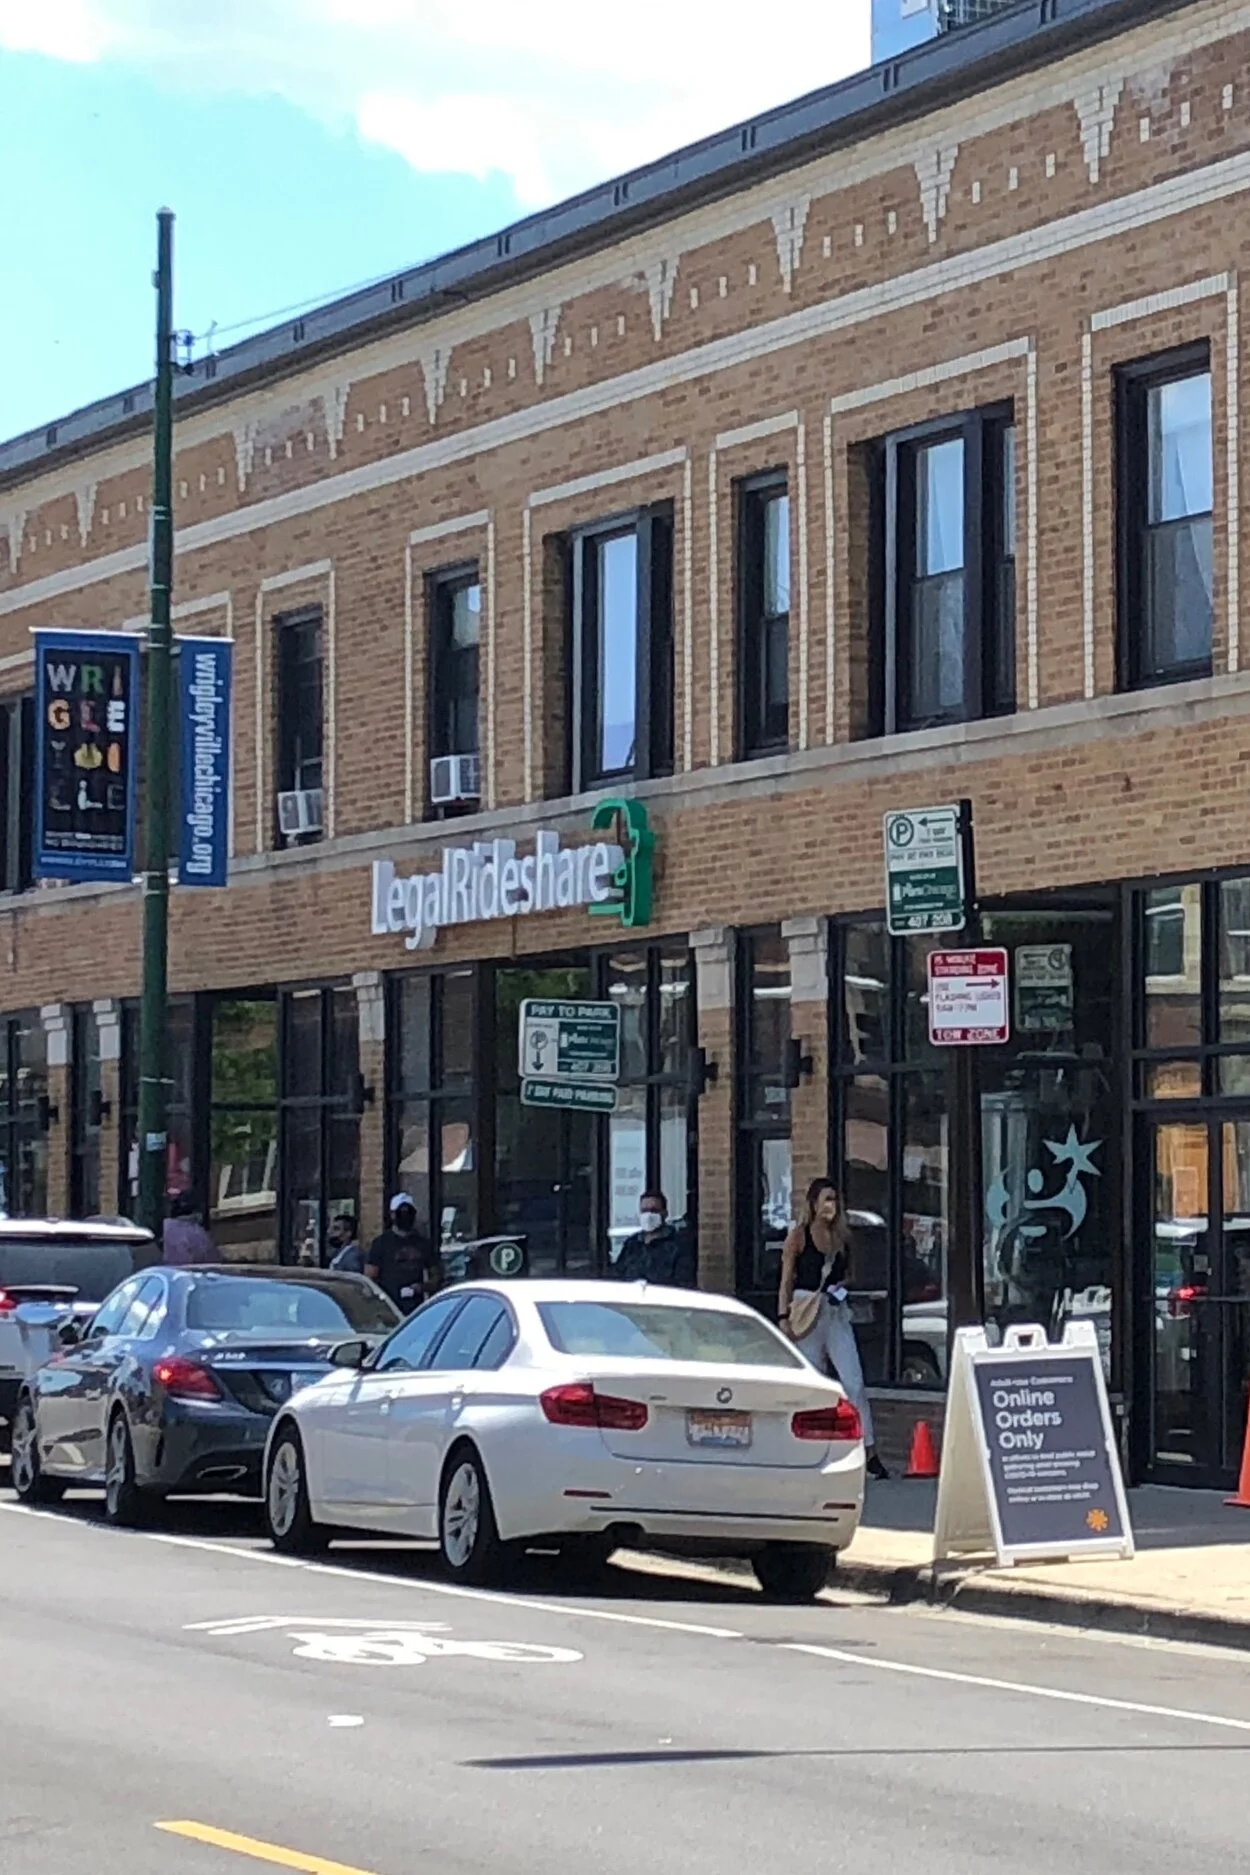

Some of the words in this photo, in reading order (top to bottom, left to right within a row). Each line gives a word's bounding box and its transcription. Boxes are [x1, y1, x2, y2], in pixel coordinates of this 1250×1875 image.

[185, 653, 224, 875] wrigleyvillechicago.org
[372, 830, 618, 951] LegalRideshare
[993, 1388, 1055, 1408] Online
[995, 1409, 1063, 1429] Orders
[998, 1429, 1044, 1450] Only
